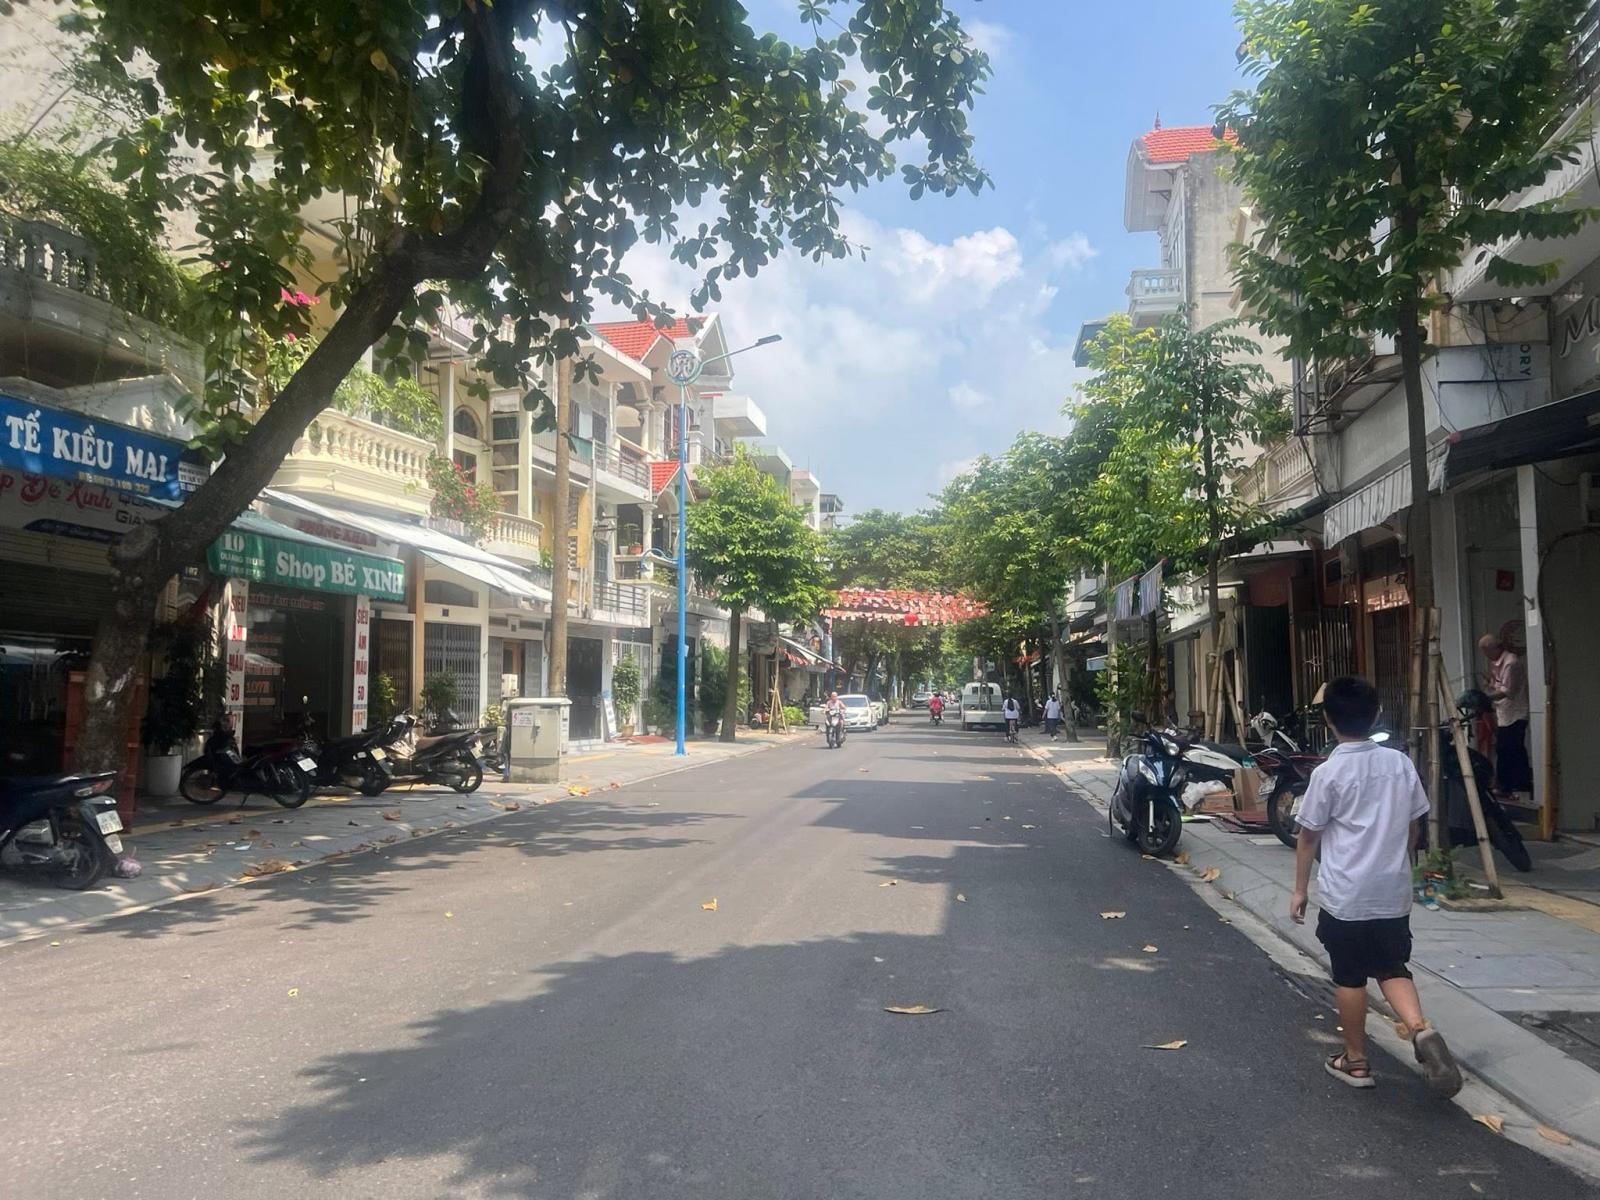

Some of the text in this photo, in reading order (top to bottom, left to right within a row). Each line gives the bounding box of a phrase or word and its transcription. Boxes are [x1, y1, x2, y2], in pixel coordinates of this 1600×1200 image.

[6, 409, 42, 454] TẾ
[52, 425, 114, 470] KIỀU
[125, 446, 168, 482] MAI
[276, 552, 326, 587] Shop
[331, 557, 357, 587] BÉ
[363, 567, 404, 594] XINH
